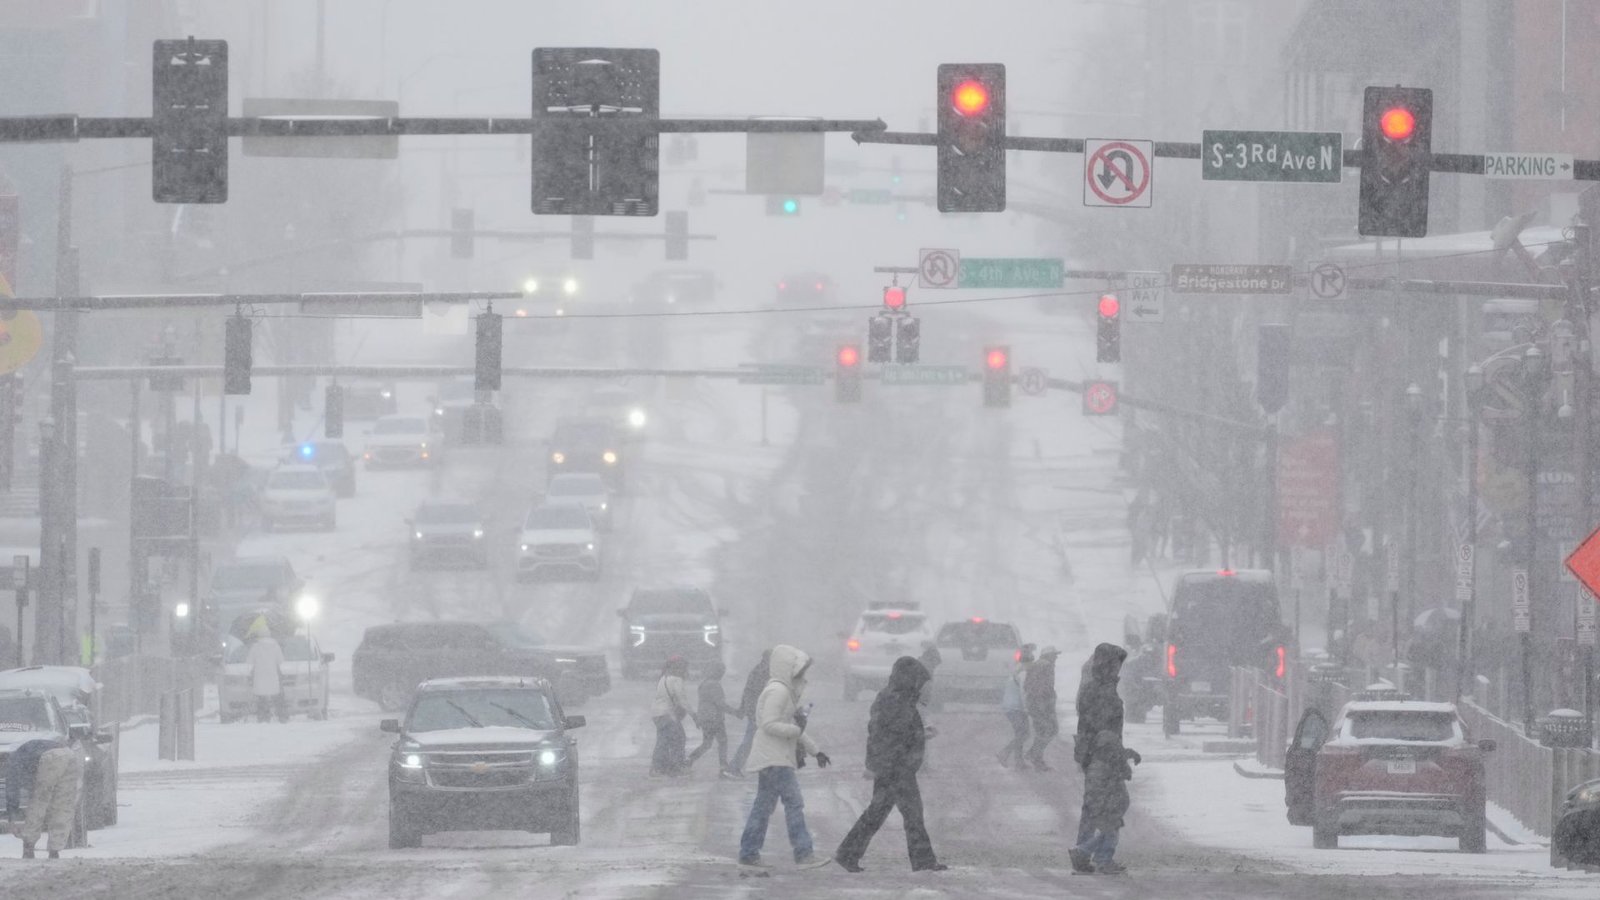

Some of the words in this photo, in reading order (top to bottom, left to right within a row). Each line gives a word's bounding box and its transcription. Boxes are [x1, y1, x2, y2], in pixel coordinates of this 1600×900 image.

[1281, 150, 1316, 170] Ave
[1320, 145, 1333, 170] N
[1485, 156, 1555, 176] PARKING
[1133, 276, 1159, 288] ONE
[1178, 275, 1268, 291] Bridgestone
[1271, 279, 1285, 289] Dr
[1132, 291, 1159, 302] WAY
